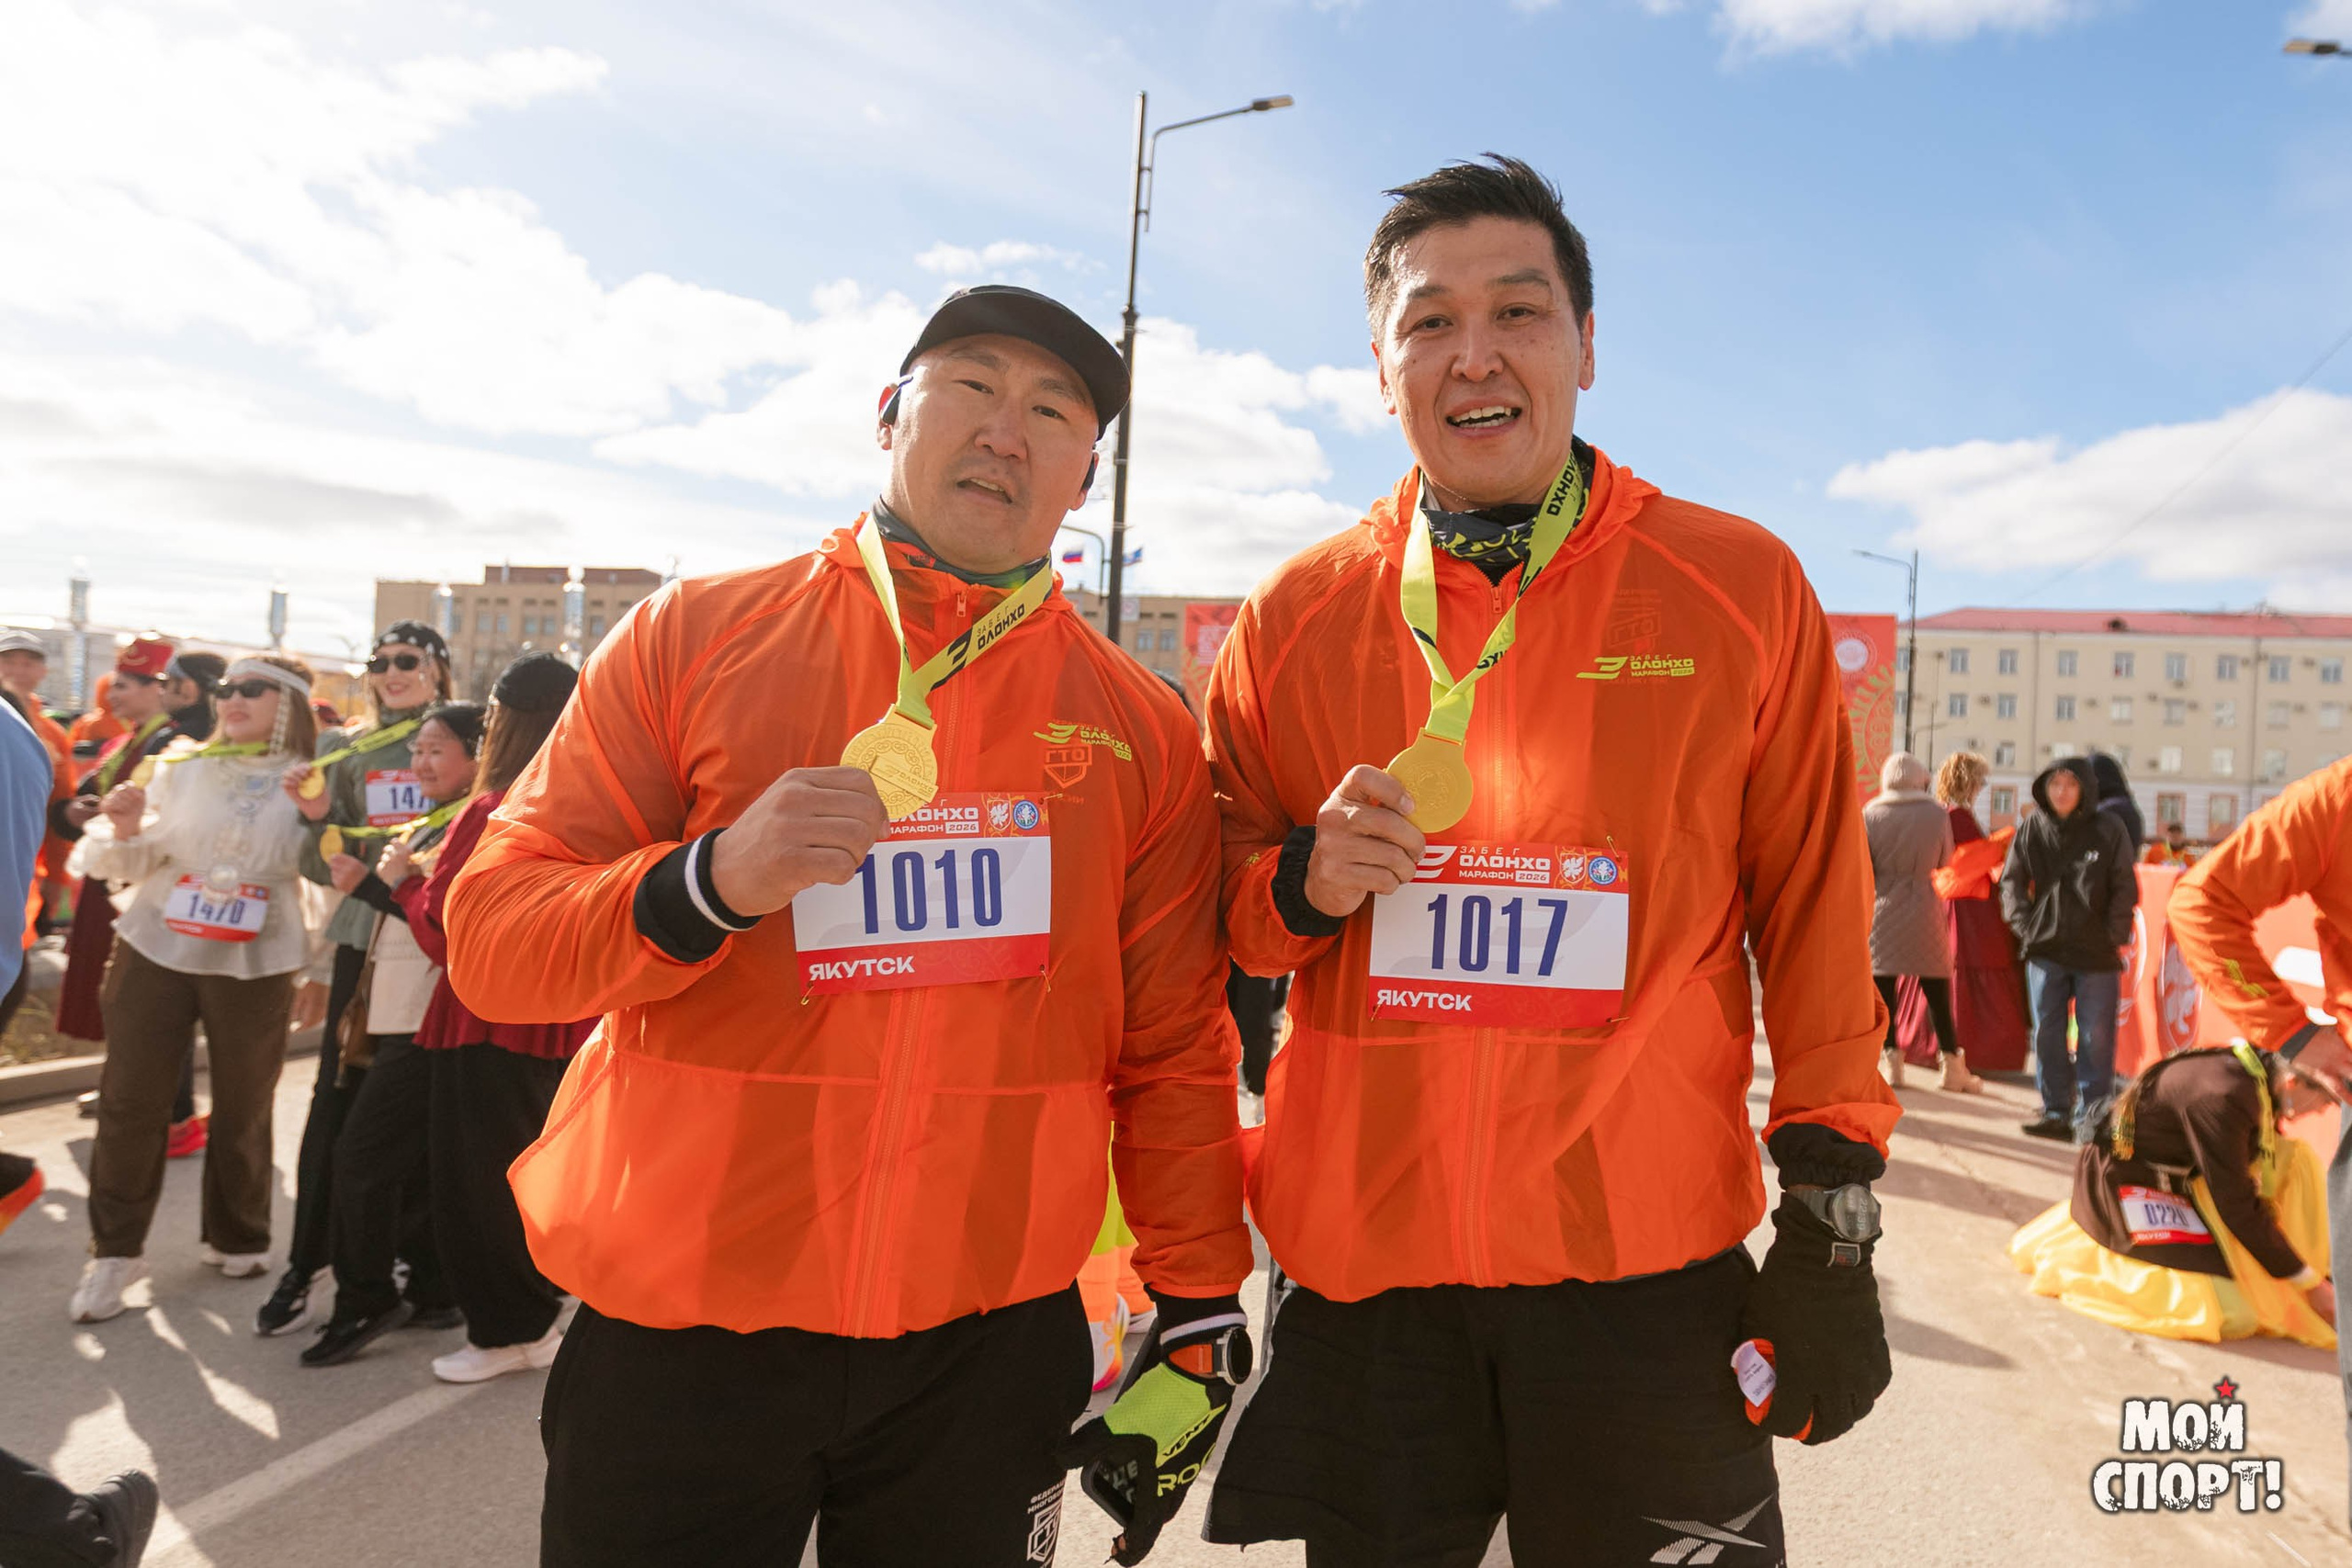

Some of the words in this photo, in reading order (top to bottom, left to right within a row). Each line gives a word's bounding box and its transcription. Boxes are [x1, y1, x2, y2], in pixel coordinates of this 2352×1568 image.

[978, 603, 1025, 650] ОЛОНХО
[1631, 659, 1694, 670] ОЛОНХО
[947, 823, 977, 831] 2026
[1460, 846, 1521, 856] ЗАБЕГ
[1459, 854, 1551, 871] ОЛОНХО
[1459, 869, 1514, 880] МАРАФОН
[1518, 873, 1548, 882] 2026
[854, 848, 1003, 934] 1010
[1428, 894, 1568, 976] 1017
[808, 955, 915, 981] ЯКУТСК
[1376, 989, 1472, 1011] ЯКУТСК
